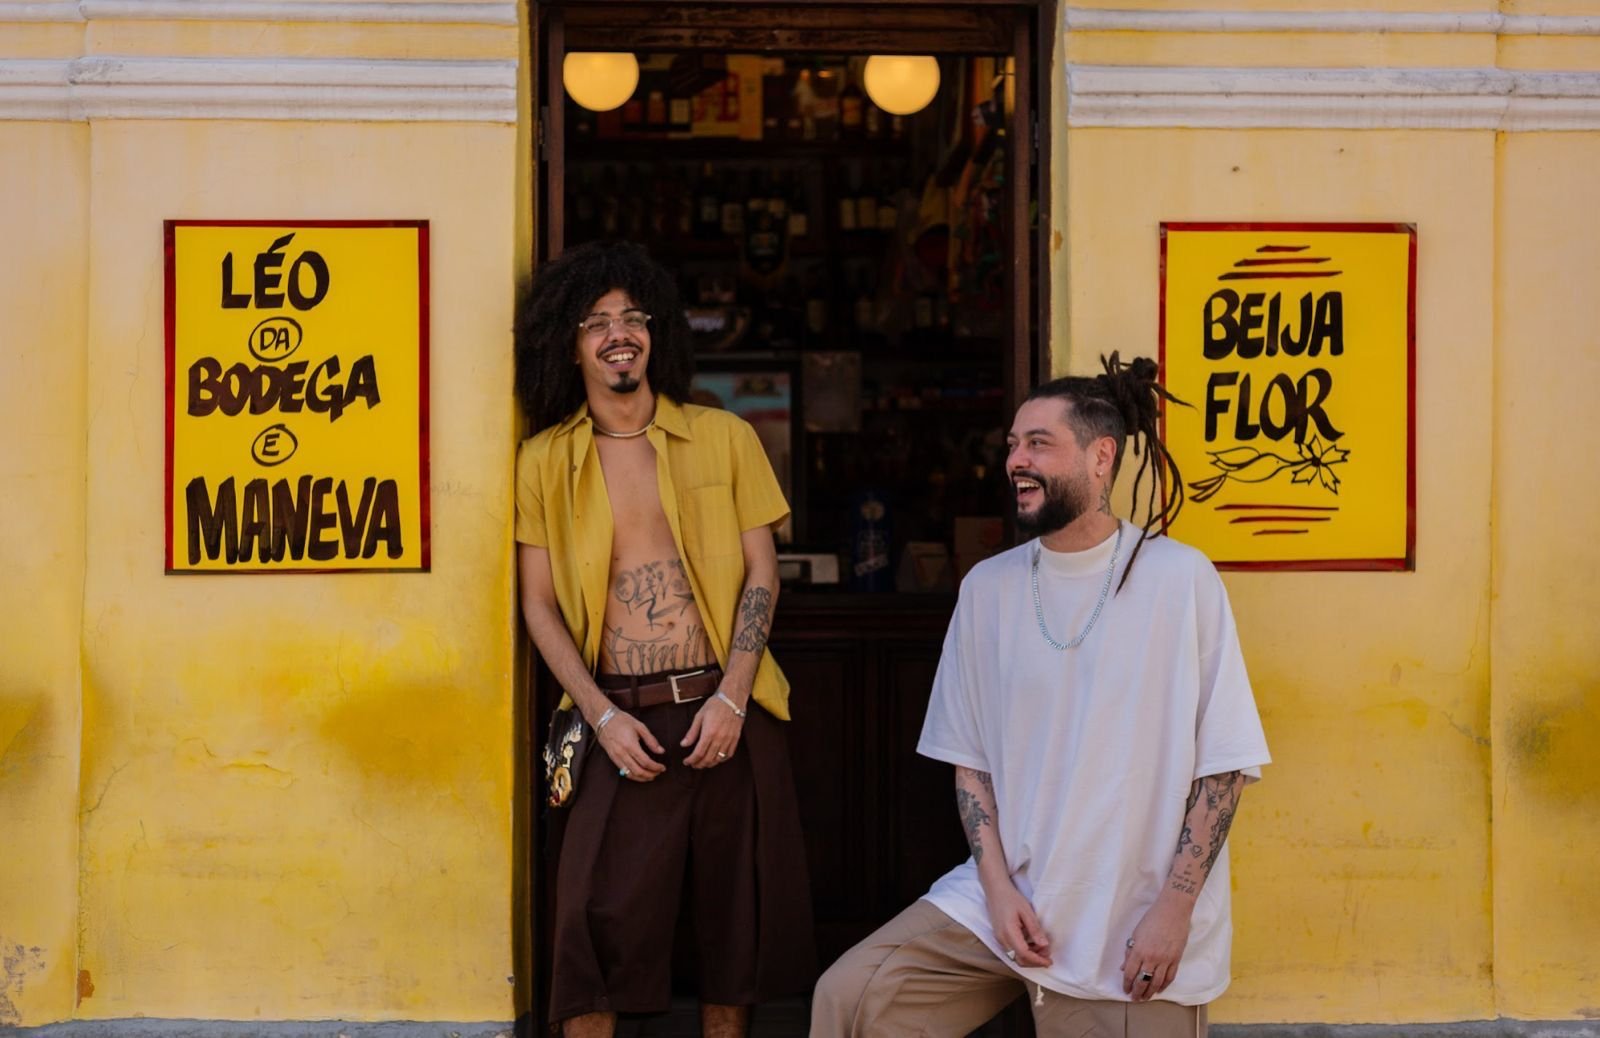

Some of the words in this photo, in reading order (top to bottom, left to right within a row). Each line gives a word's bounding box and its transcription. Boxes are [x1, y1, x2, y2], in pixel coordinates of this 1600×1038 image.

[222, 233, 329, 311] LÉO
[259, 327, 291, 352] DA
[1203, 289, 1343, 360] BEIJA
[187, 354, 380, 423] BODEGA
[1205, 368, 1344, 444] FLOR
[261, 433, 280, 457] E
[186, 475, 403, 565] MANEVA
